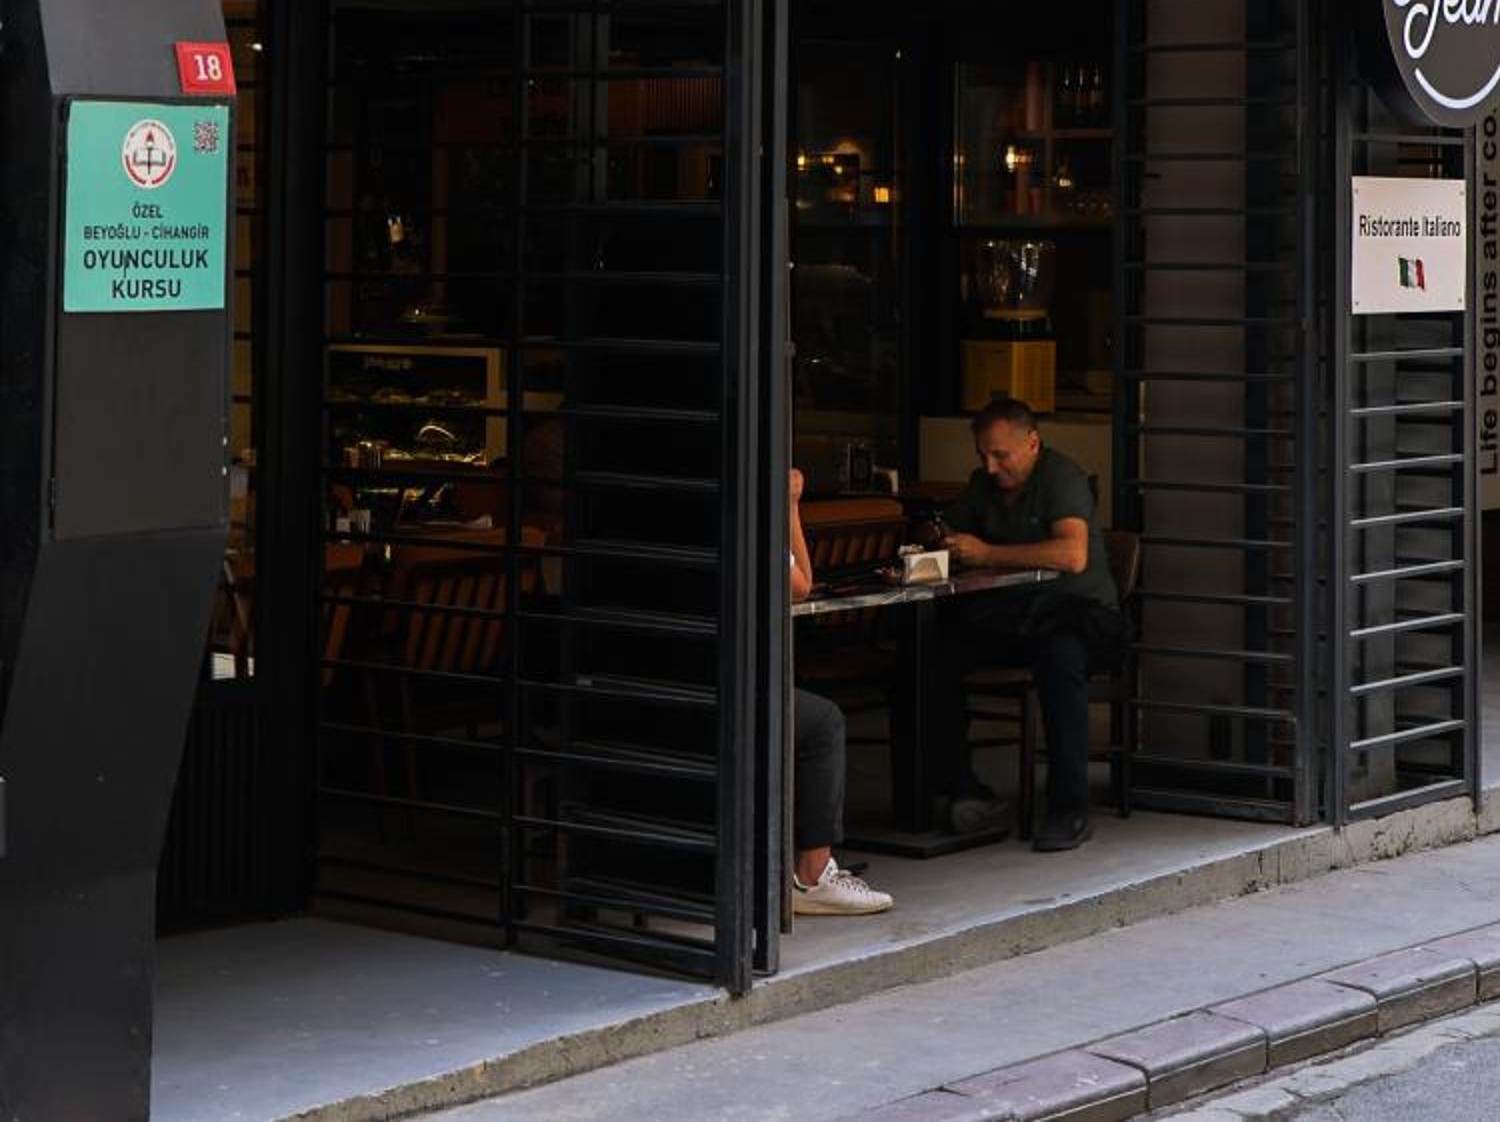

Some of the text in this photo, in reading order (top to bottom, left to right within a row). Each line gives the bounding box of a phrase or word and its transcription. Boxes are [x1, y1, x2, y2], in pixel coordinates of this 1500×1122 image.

[193, 54, 223, 81] 18
[132, 201, 164, 219] ÖZEL
[1479, 172, 1498, 261] after
[83, 223, 141, 240] BEYOĞLU
[151, 223, 209, 240] CİHANGİR
[1359, 214, 1461, 237] Ristorante Italiano
[83, 249, 208, 269] OYUNCULUK
[112, 279, 181, 299] KURSU
[1479, 409, 1498, 475] Life
